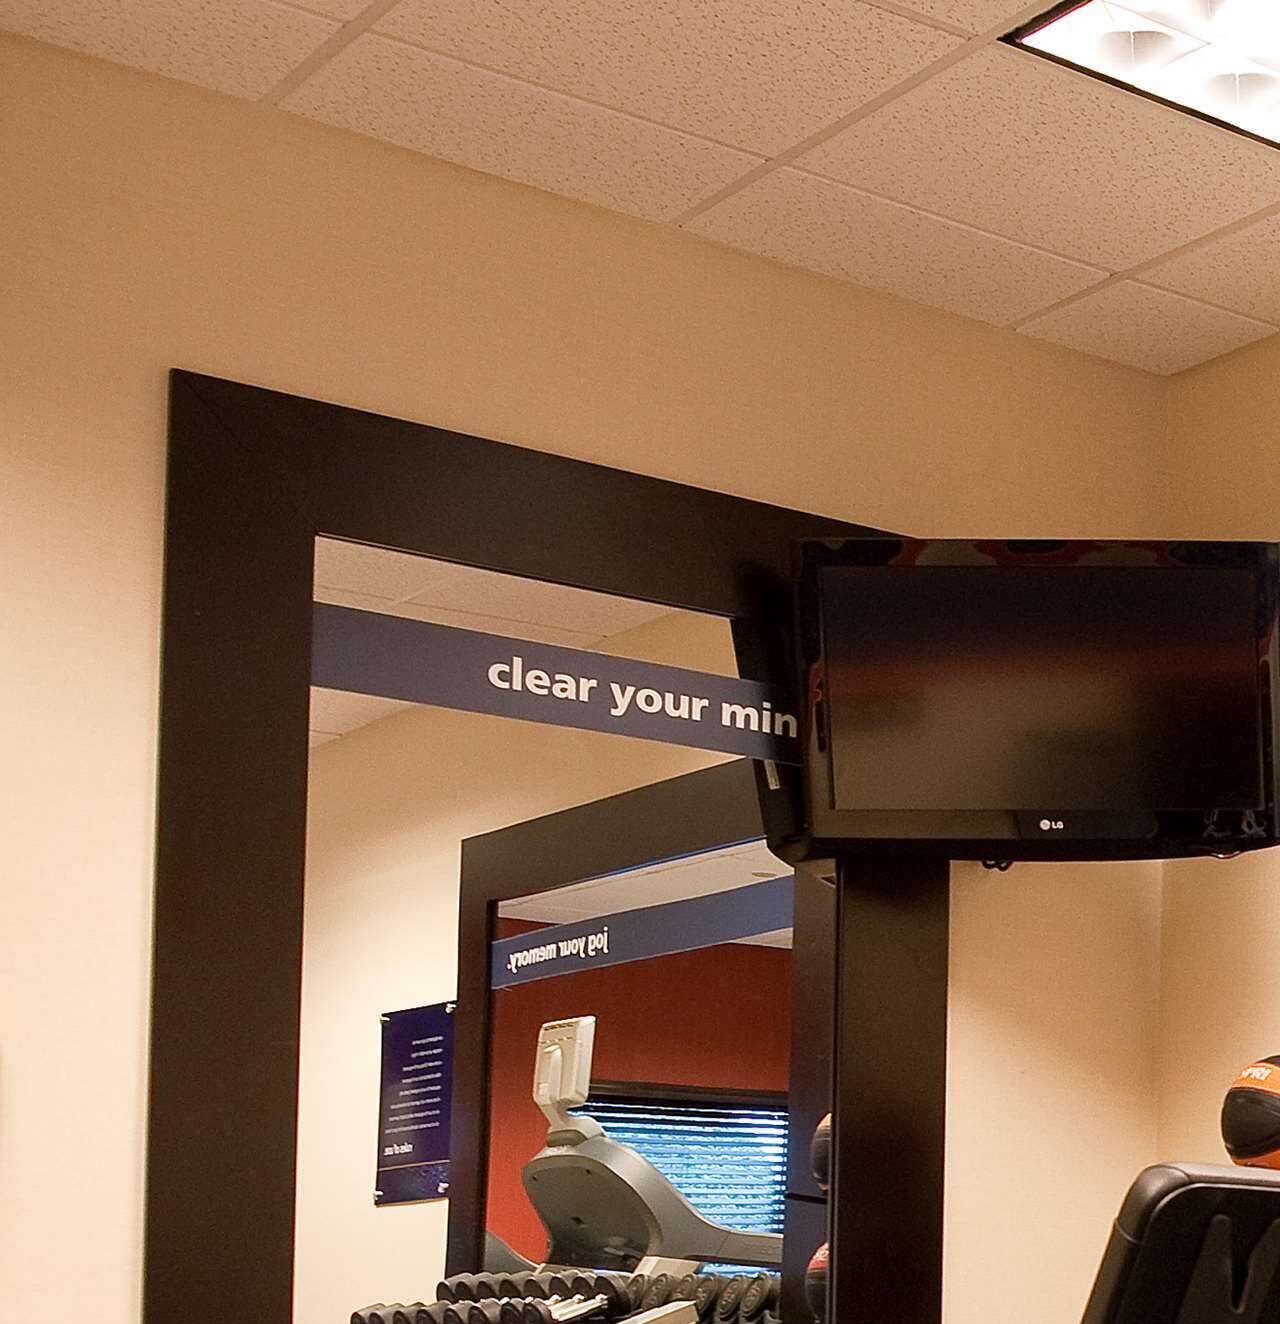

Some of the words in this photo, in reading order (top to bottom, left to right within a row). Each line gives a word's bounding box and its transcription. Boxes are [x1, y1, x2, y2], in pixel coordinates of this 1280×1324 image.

[487, 656, 598, 702] clear
[609, 680, 710, 722] your
[721, 701, 798, 738] min
[1051, 820, 1064, 829] LG
